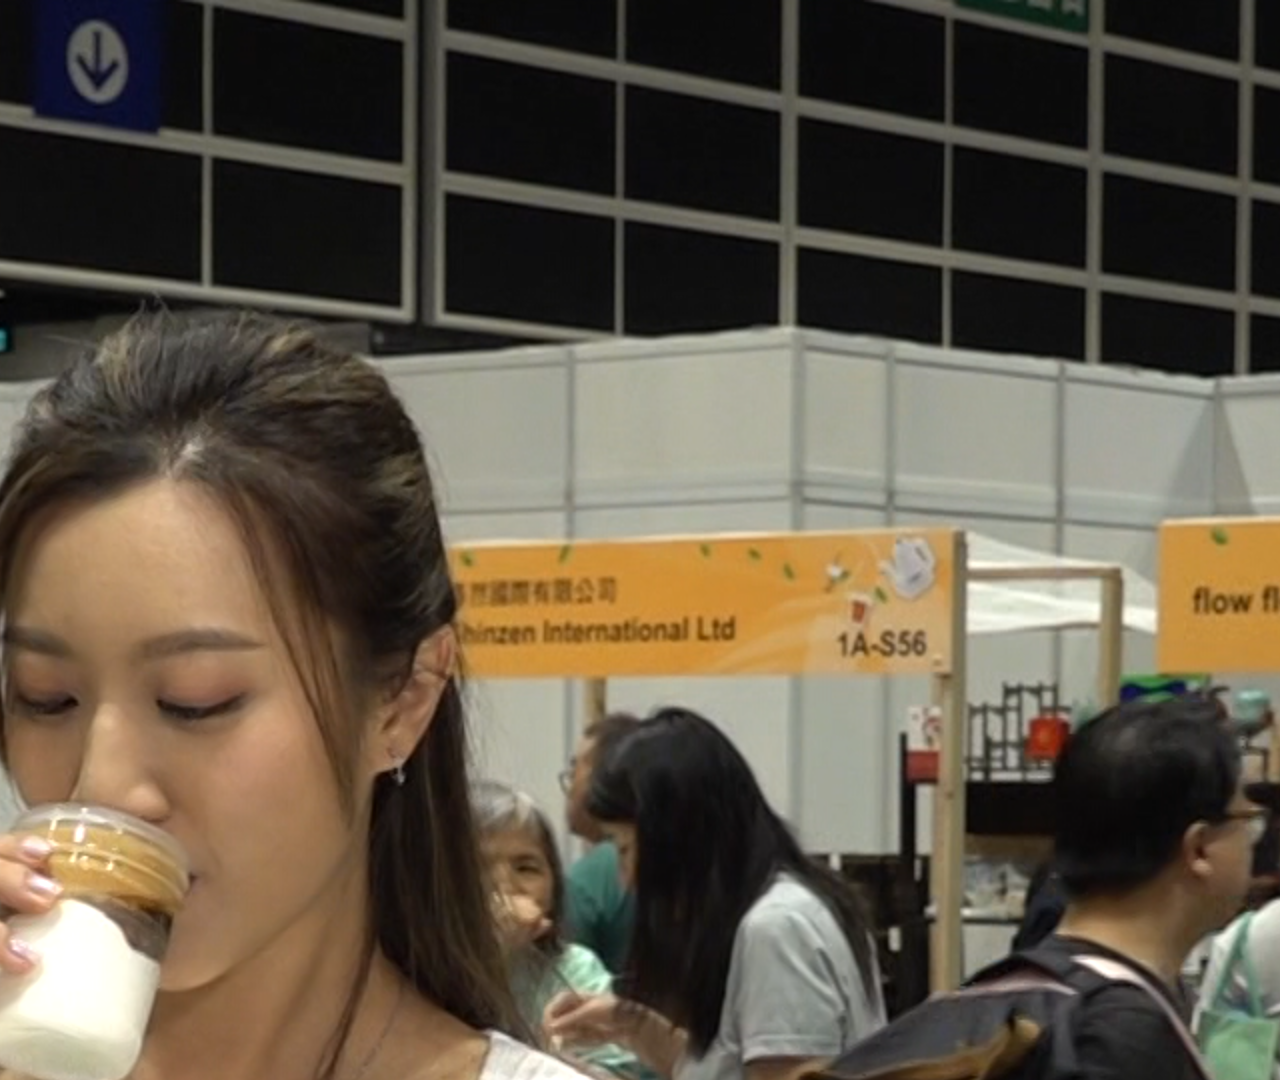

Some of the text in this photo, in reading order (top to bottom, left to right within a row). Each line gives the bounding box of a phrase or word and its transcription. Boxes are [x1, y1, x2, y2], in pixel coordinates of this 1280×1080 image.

[456, 576, 617, 607] 然國際有限公司
[1193, 587, 1253, 614] flow
[543, 617, 689, 643] International
[696, 615, 736, 642] Ltd
[836, 630, 927, 659] 1A-S56
